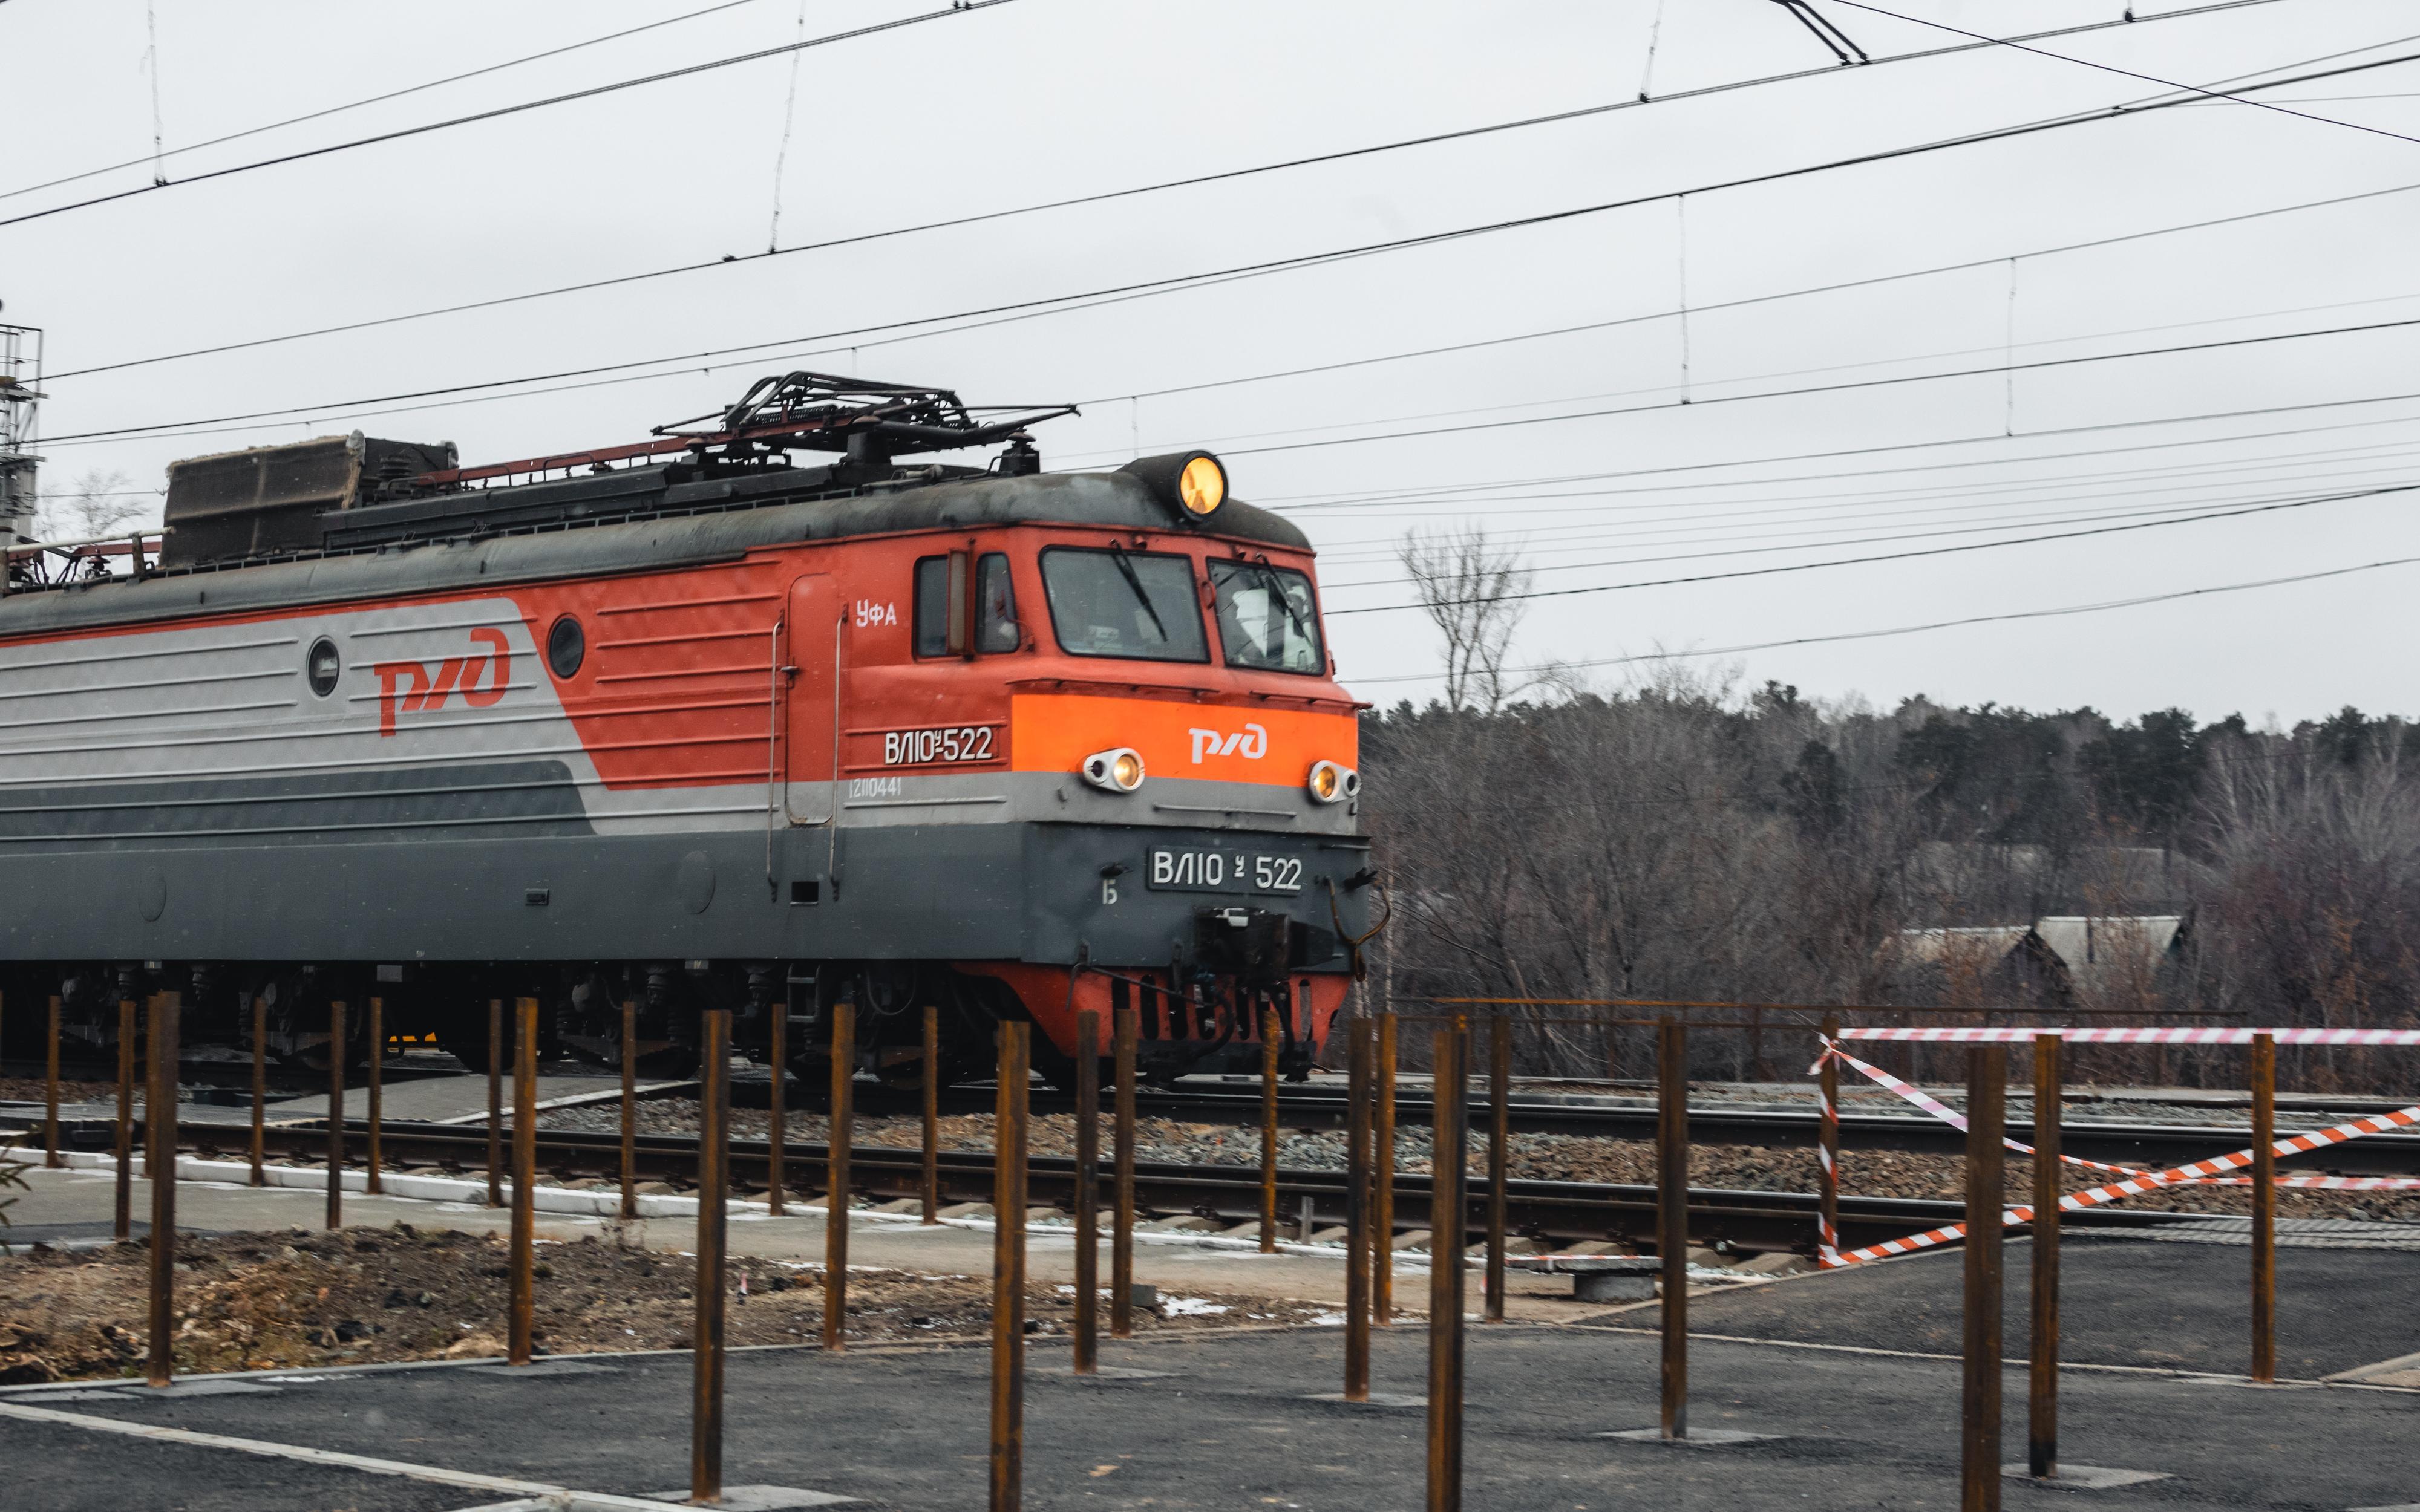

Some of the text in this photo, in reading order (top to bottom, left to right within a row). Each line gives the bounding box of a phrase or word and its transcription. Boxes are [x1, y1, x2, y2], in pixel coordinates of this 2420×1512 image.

[855, 599, 897, 628] УФА
[1153, 850, 1223, 886] ВЛ10
[1255, 856, 1302, 891] 522
[1103, 879, 1117, 905] Б
